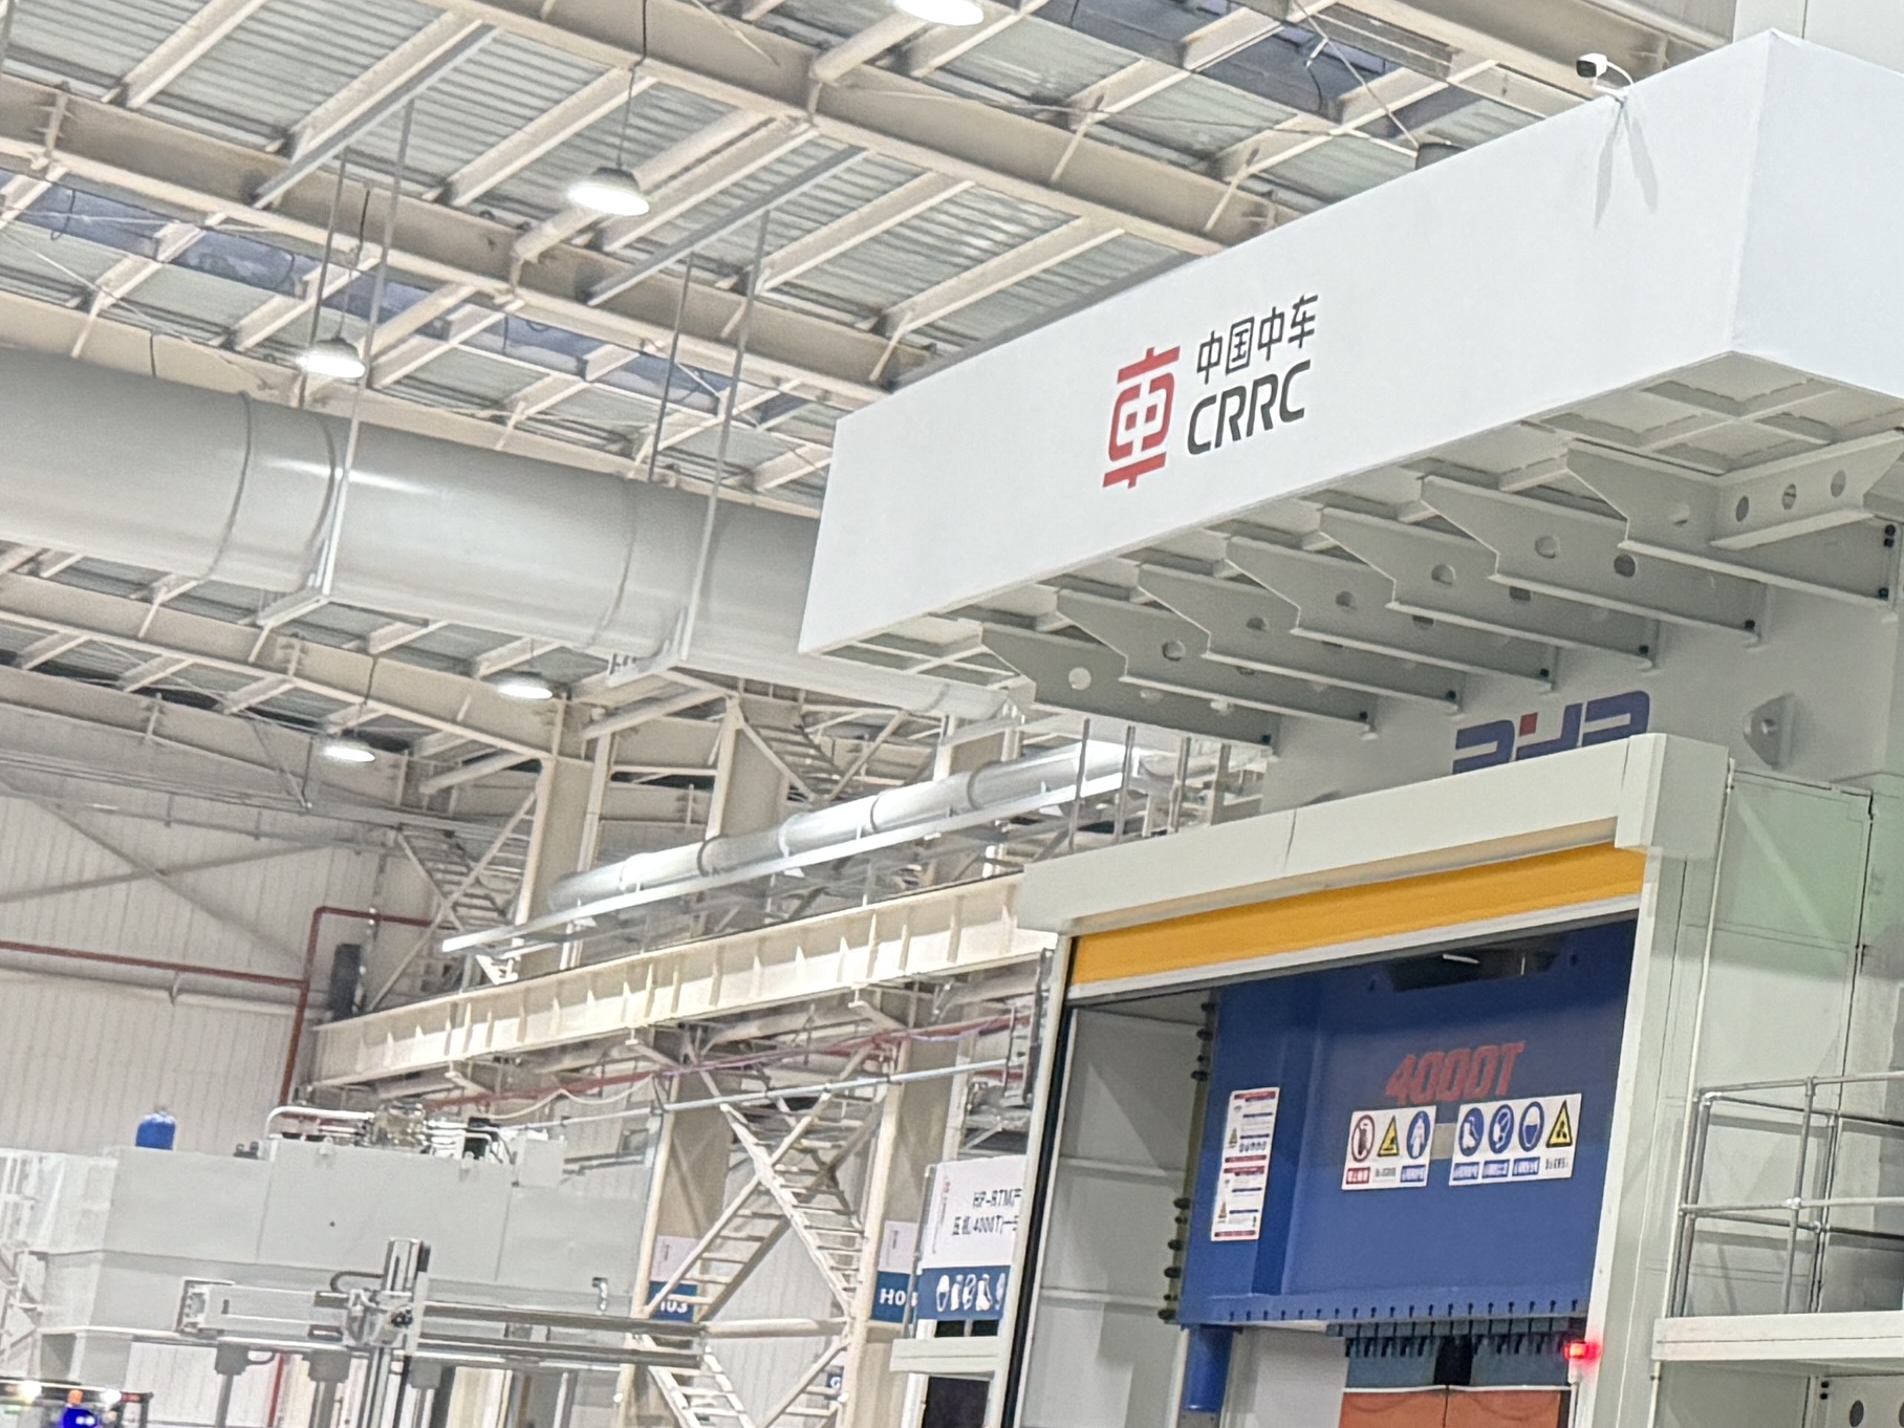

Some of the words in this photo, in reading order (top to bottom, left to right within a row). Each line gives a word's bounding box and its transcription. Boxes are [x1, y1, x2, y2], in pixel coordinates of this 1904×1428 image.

[1196, 294, 1319, 385] 中国中车
[1187, 358, 1312, 456] CRRC
[1385, 1040, 1526, 1106] 4000T
